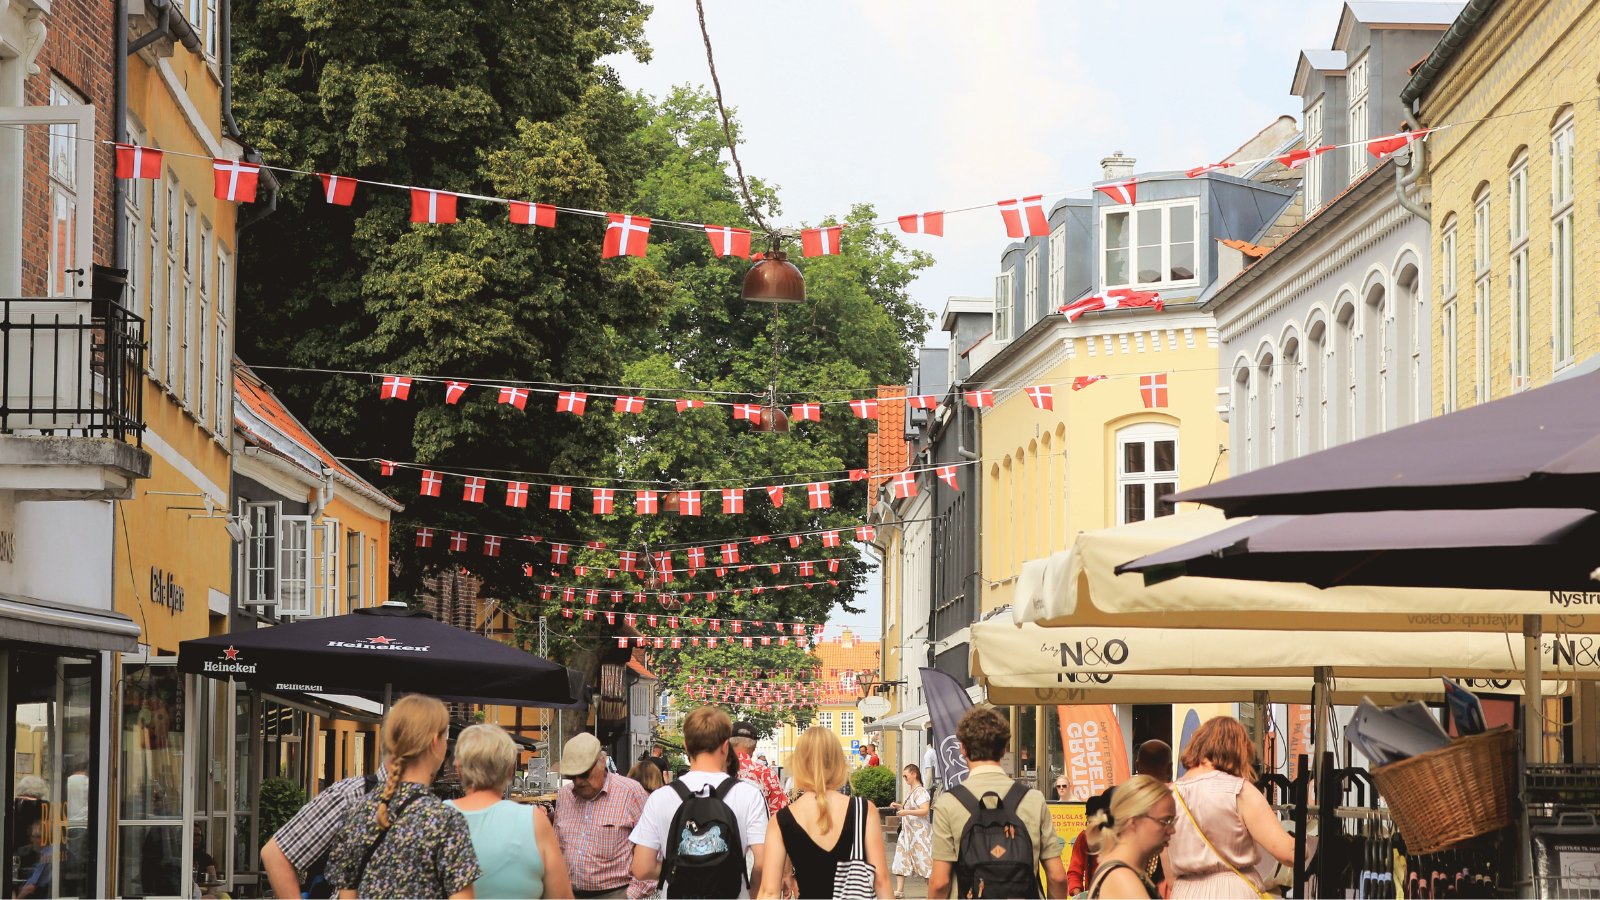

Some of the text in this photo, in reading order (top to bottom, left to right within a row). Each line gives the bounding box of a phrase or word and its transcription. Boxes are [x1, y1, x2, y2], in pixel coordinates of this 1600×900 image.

[327, 640, 430, 651] Heineken
[203, 661, 256, 673] Heineken
[1289, 736, 1298, 759] ALLE
[41, 801, 68, 847] BOSS
